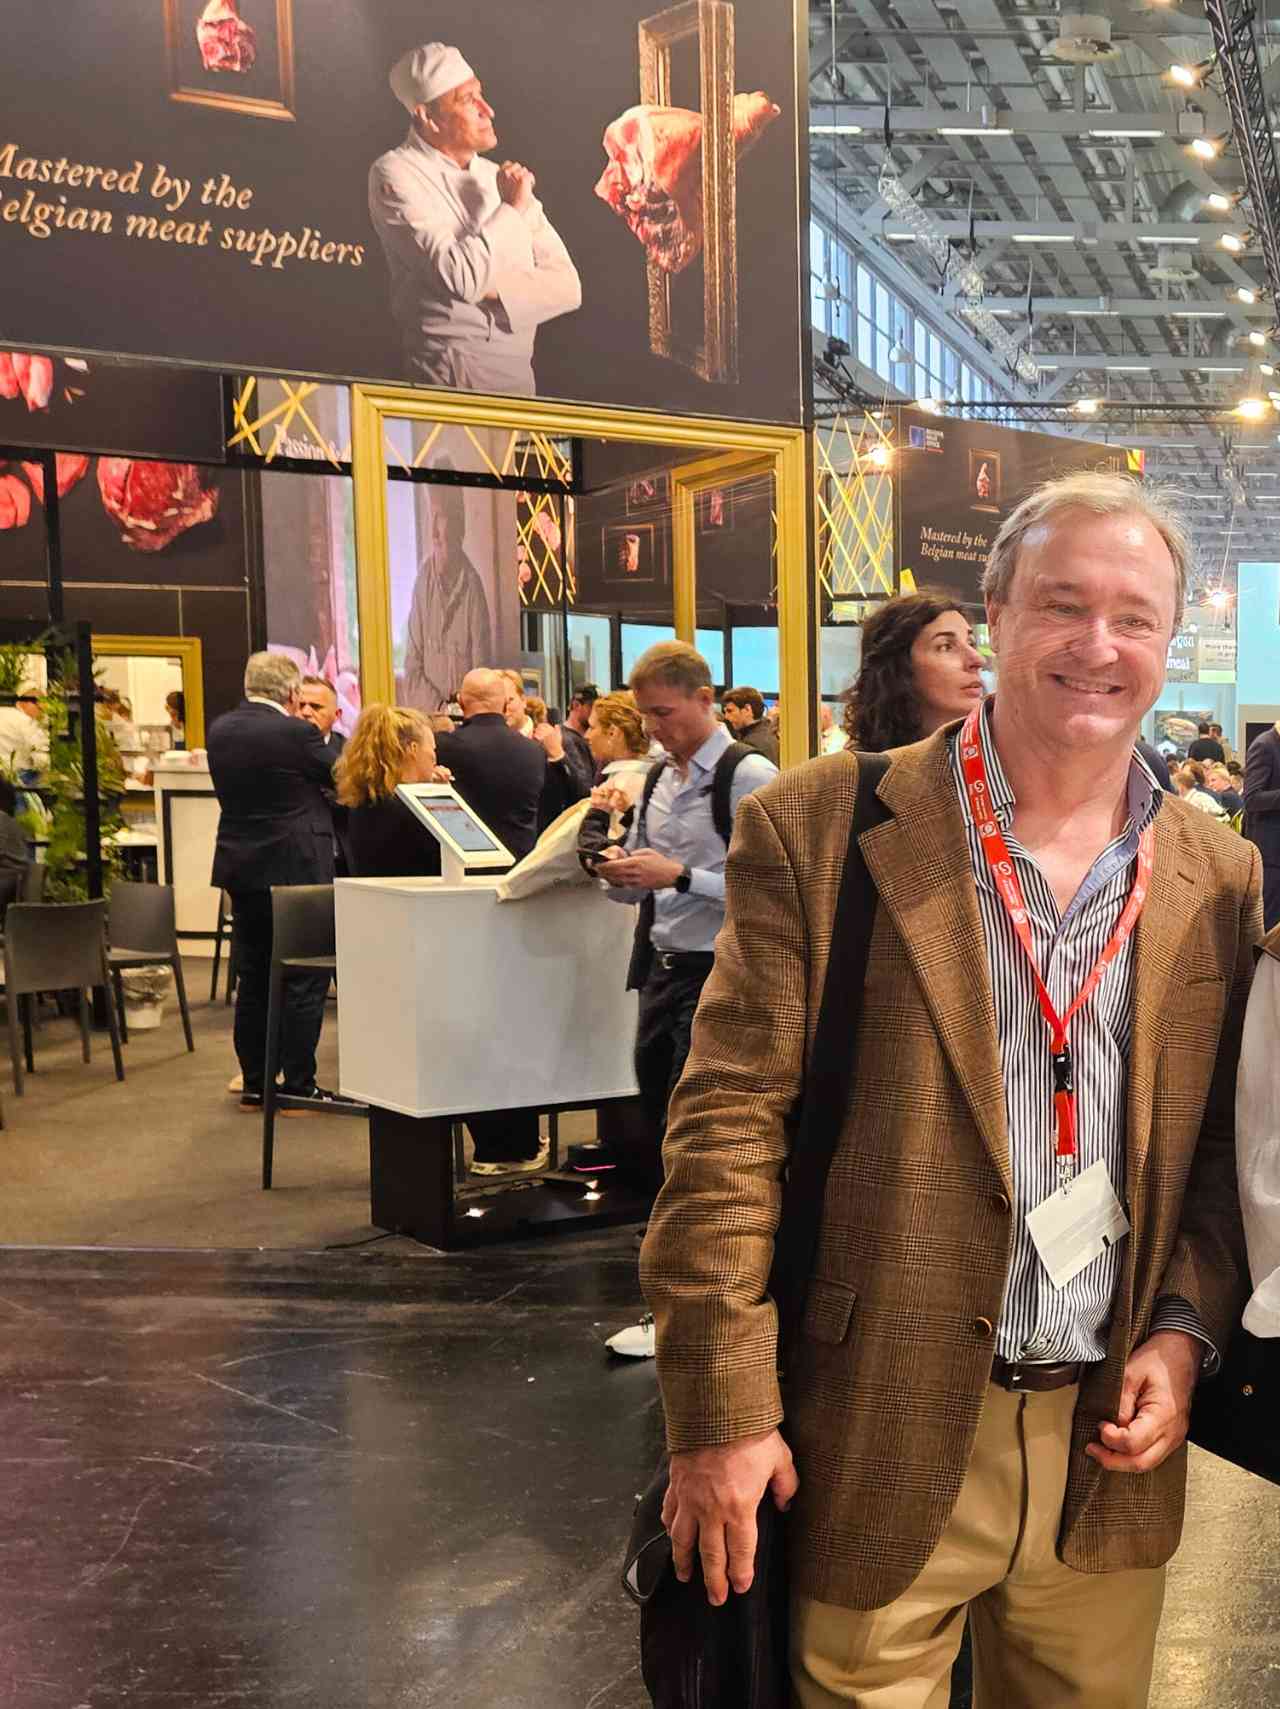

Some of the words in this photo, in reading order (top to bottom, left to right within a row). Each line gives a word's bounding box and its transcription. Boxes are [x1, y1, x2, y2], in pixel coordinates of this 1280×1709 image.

[150, 164, 192, 212] by
[200, 173, 254, 210] the
[0, 190, 113, 238] elgian
[126, 213, 213, 247] meat
[220, 226, 366, 270] suppliers
